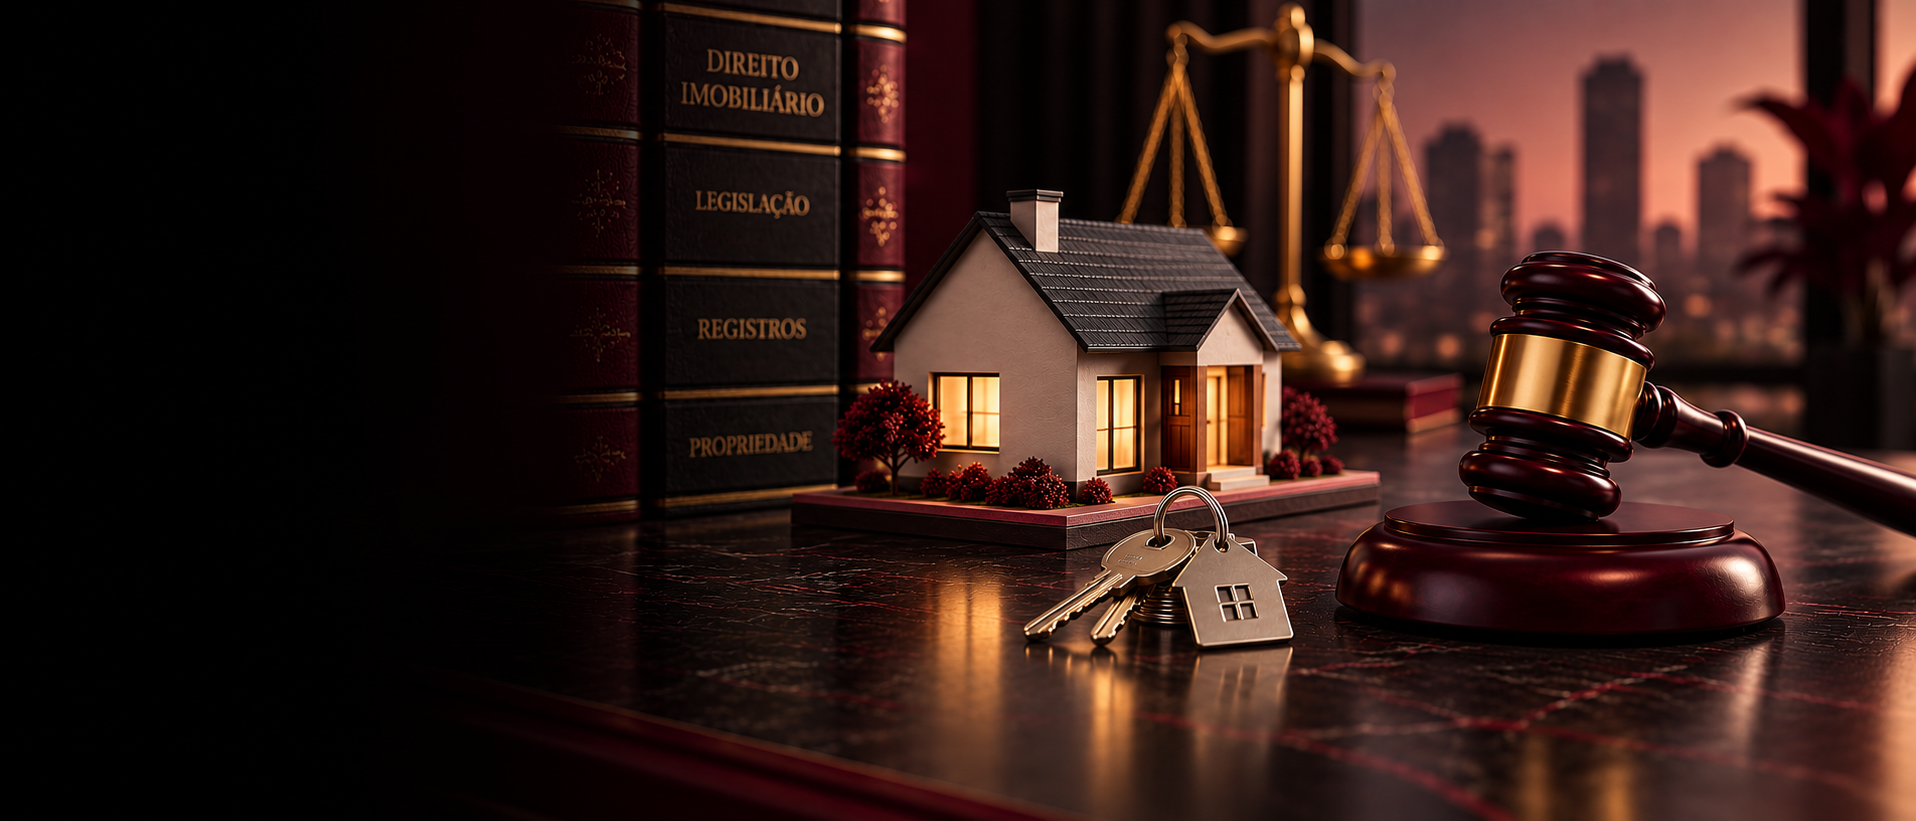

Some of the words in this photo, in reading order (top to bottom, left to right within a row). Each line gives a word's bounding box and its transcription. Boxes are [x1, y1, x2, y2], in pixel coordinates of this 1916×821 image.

[706, 49, 799, 81] DIREITO
[680, 81, 825, 117] IMOBILIÁRIO
[695, 190, 810, 219] LEGISLAÇÃO
[697, 317, 807, 340] REGISTROS
[689, 431, 813, 458] PROPRIEDADE
